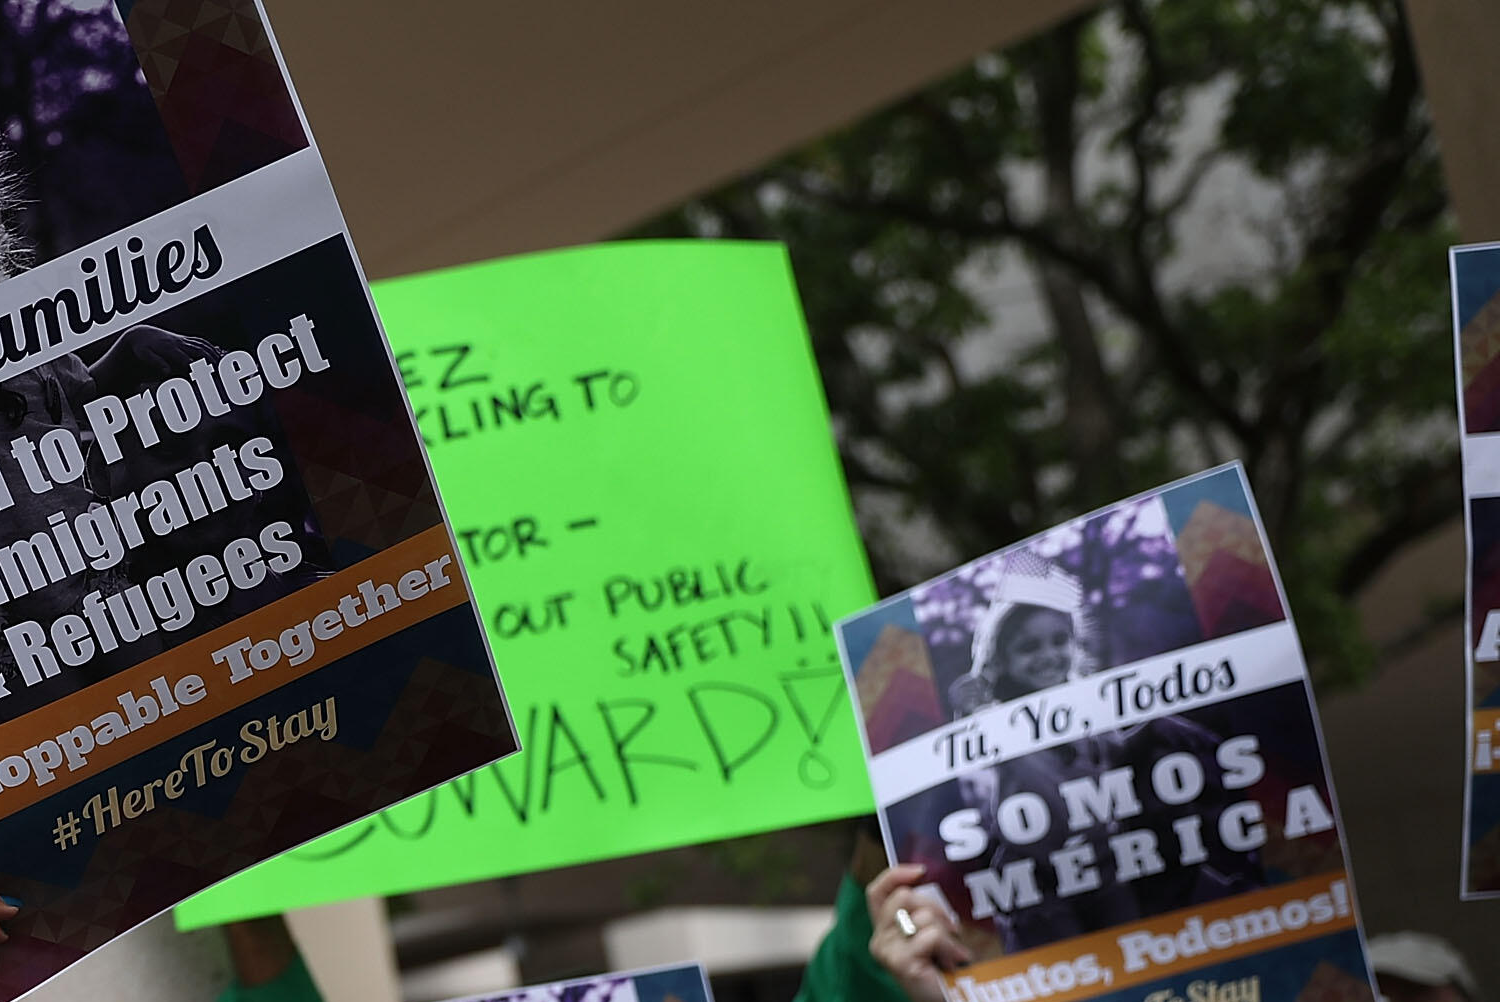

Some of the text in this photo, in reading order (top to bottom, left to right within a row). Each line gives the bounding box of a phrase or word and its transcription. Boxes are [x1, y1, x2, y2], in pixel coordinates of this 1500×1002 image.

[9, 424, 87, 497] to
[83, 313, 332, 466] Protect
[572, 366, 641, 412] TO
[456, 515, 550, 568] TOR
[603, 556, 772, 618] PUBLIC
[2, 519, 304, 688] Refugees
[211, 553, 454, 685] Together
[1009, 697, 1091, 742] Yo,
[1100, 658, 1238, 717] Todos
[52, 696, 339, 852] #HereToStay
[937, 734, 1266, 863] SOMOS
[1117, 878, 1351, 974] Podemos!
